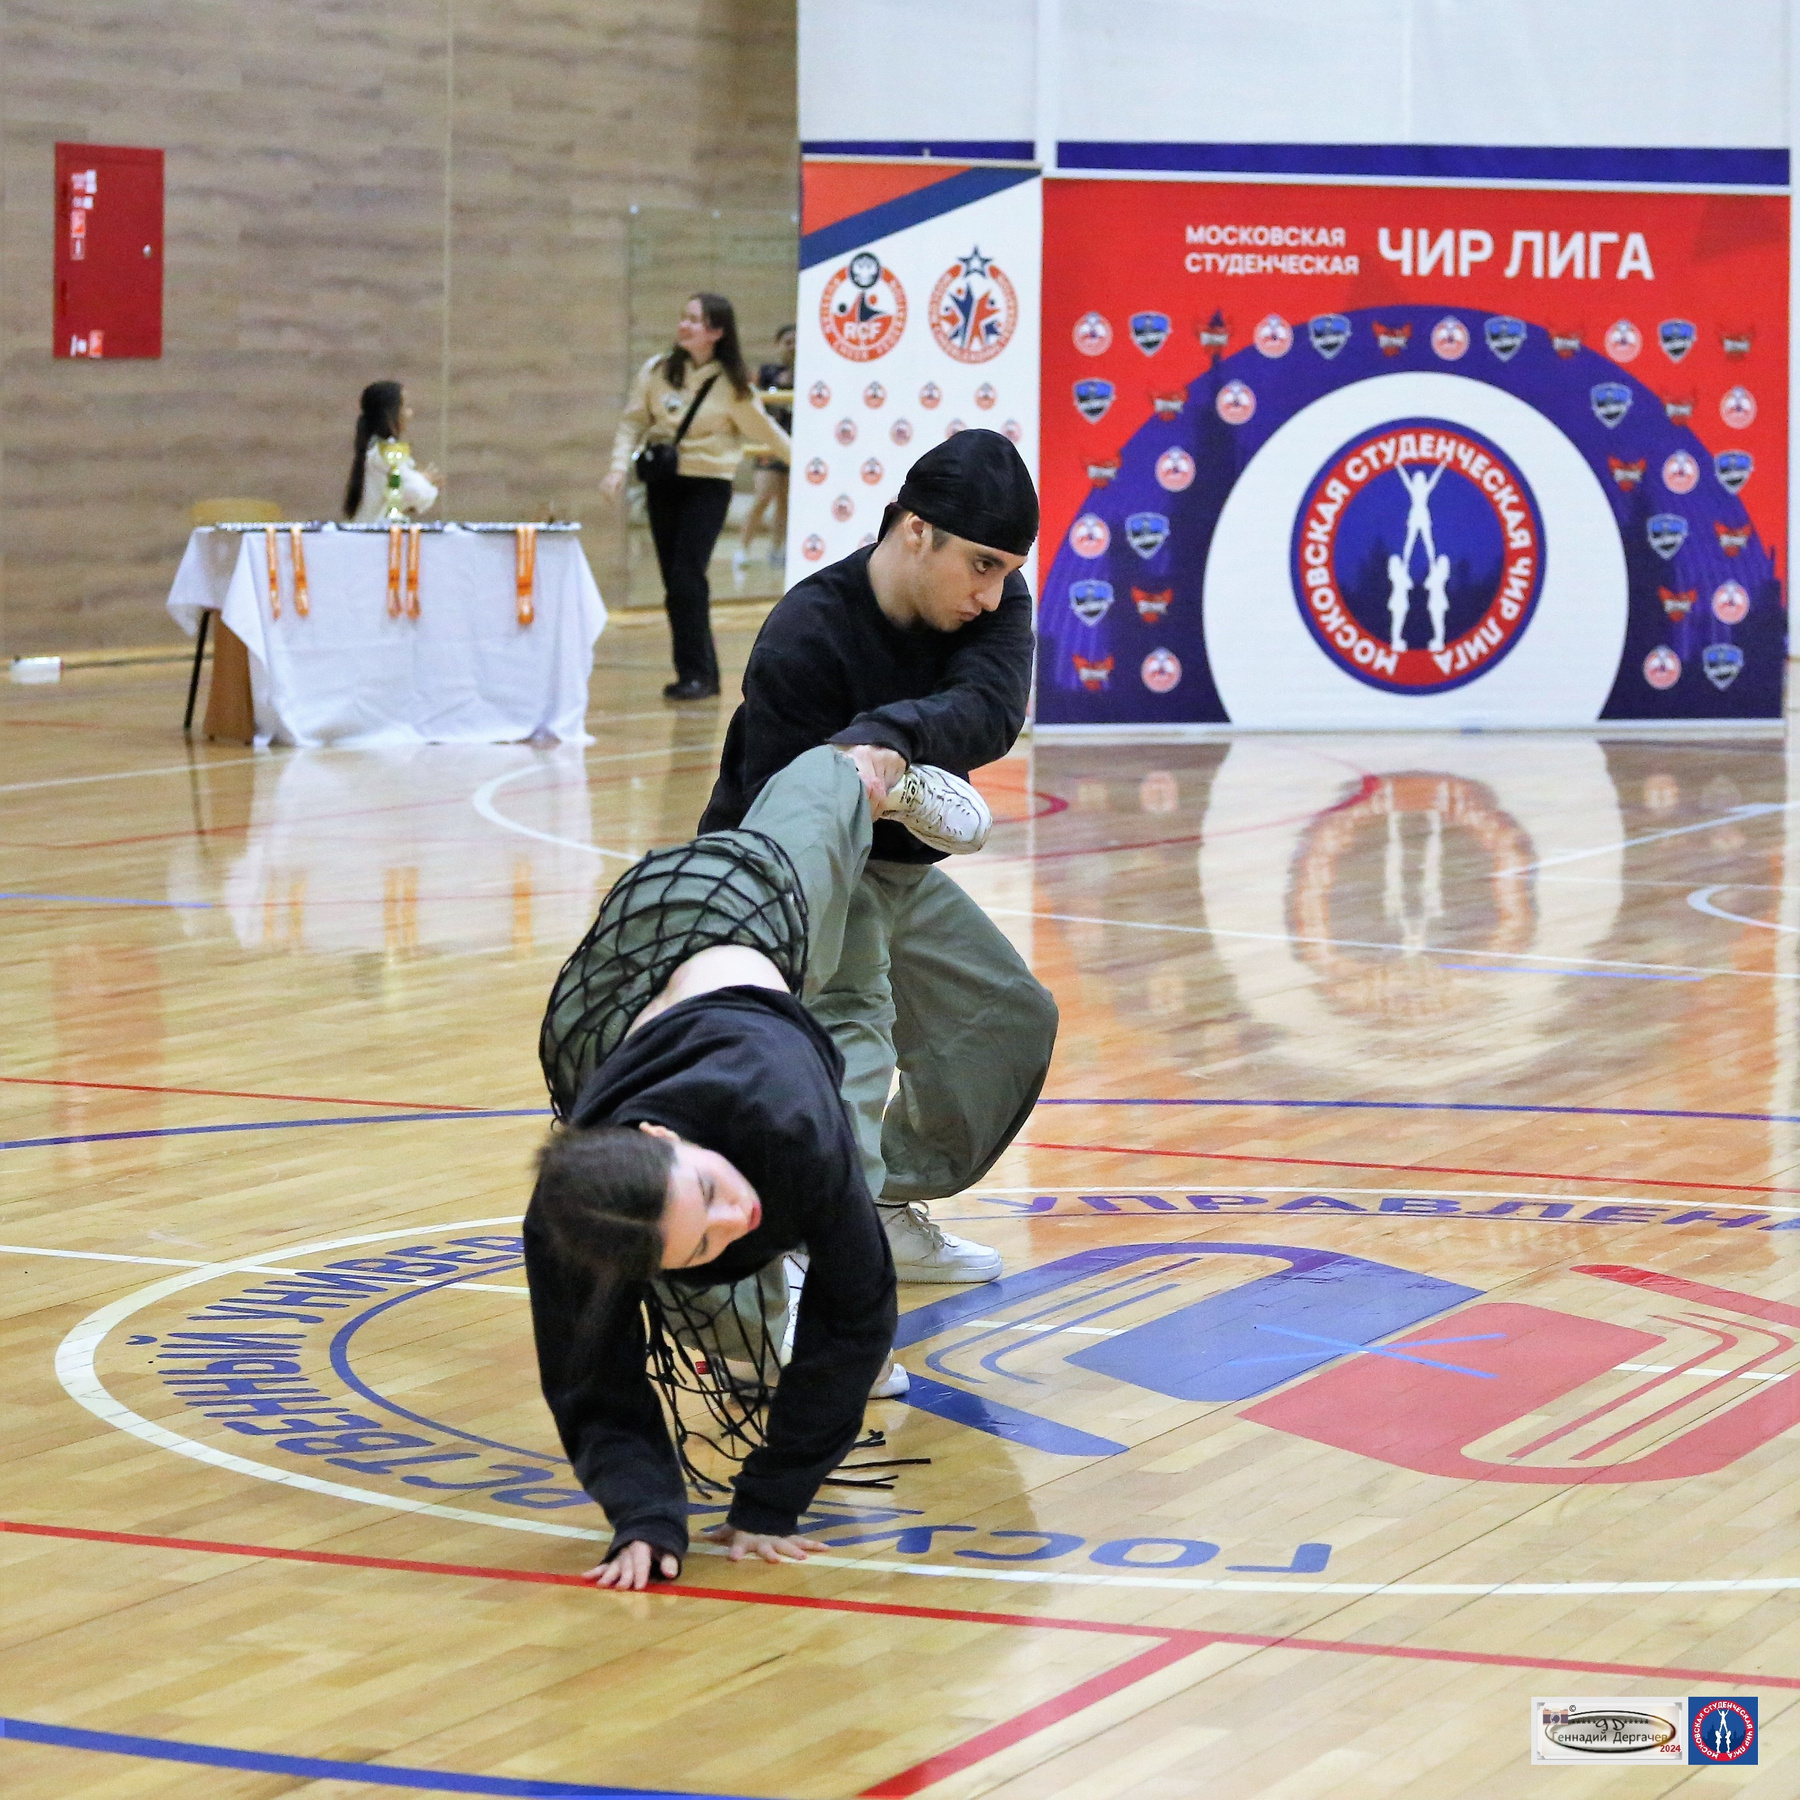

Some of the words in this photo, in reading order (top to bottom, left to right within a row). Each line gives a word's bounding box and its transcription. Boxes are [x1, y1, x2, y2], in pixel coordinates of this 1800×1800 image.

[1185, 225, 1346, 248] МОСКОВСКАЯ
[1185, 252, 1359, 276] СТУДЕНЧЕСКАЯ
[1378, 228, 1494, 277] ЧИР
[1504, 230, 1655, 280] ЛИГА
[1345, 433, 1532, 550] СТУДЕНЧЕСКАЯ
[1304, 478, 1400, 676] МОСКОВСКАЯ
[1500, 556, 1533, 621] ЧИР
[1432, 617, 1504, 675] ЛИГА
[187, 1236, 524, 1324] УНИВЕР
[125, 1331, 1332, 1574] ГОСУРСТВЕННЫЙ
